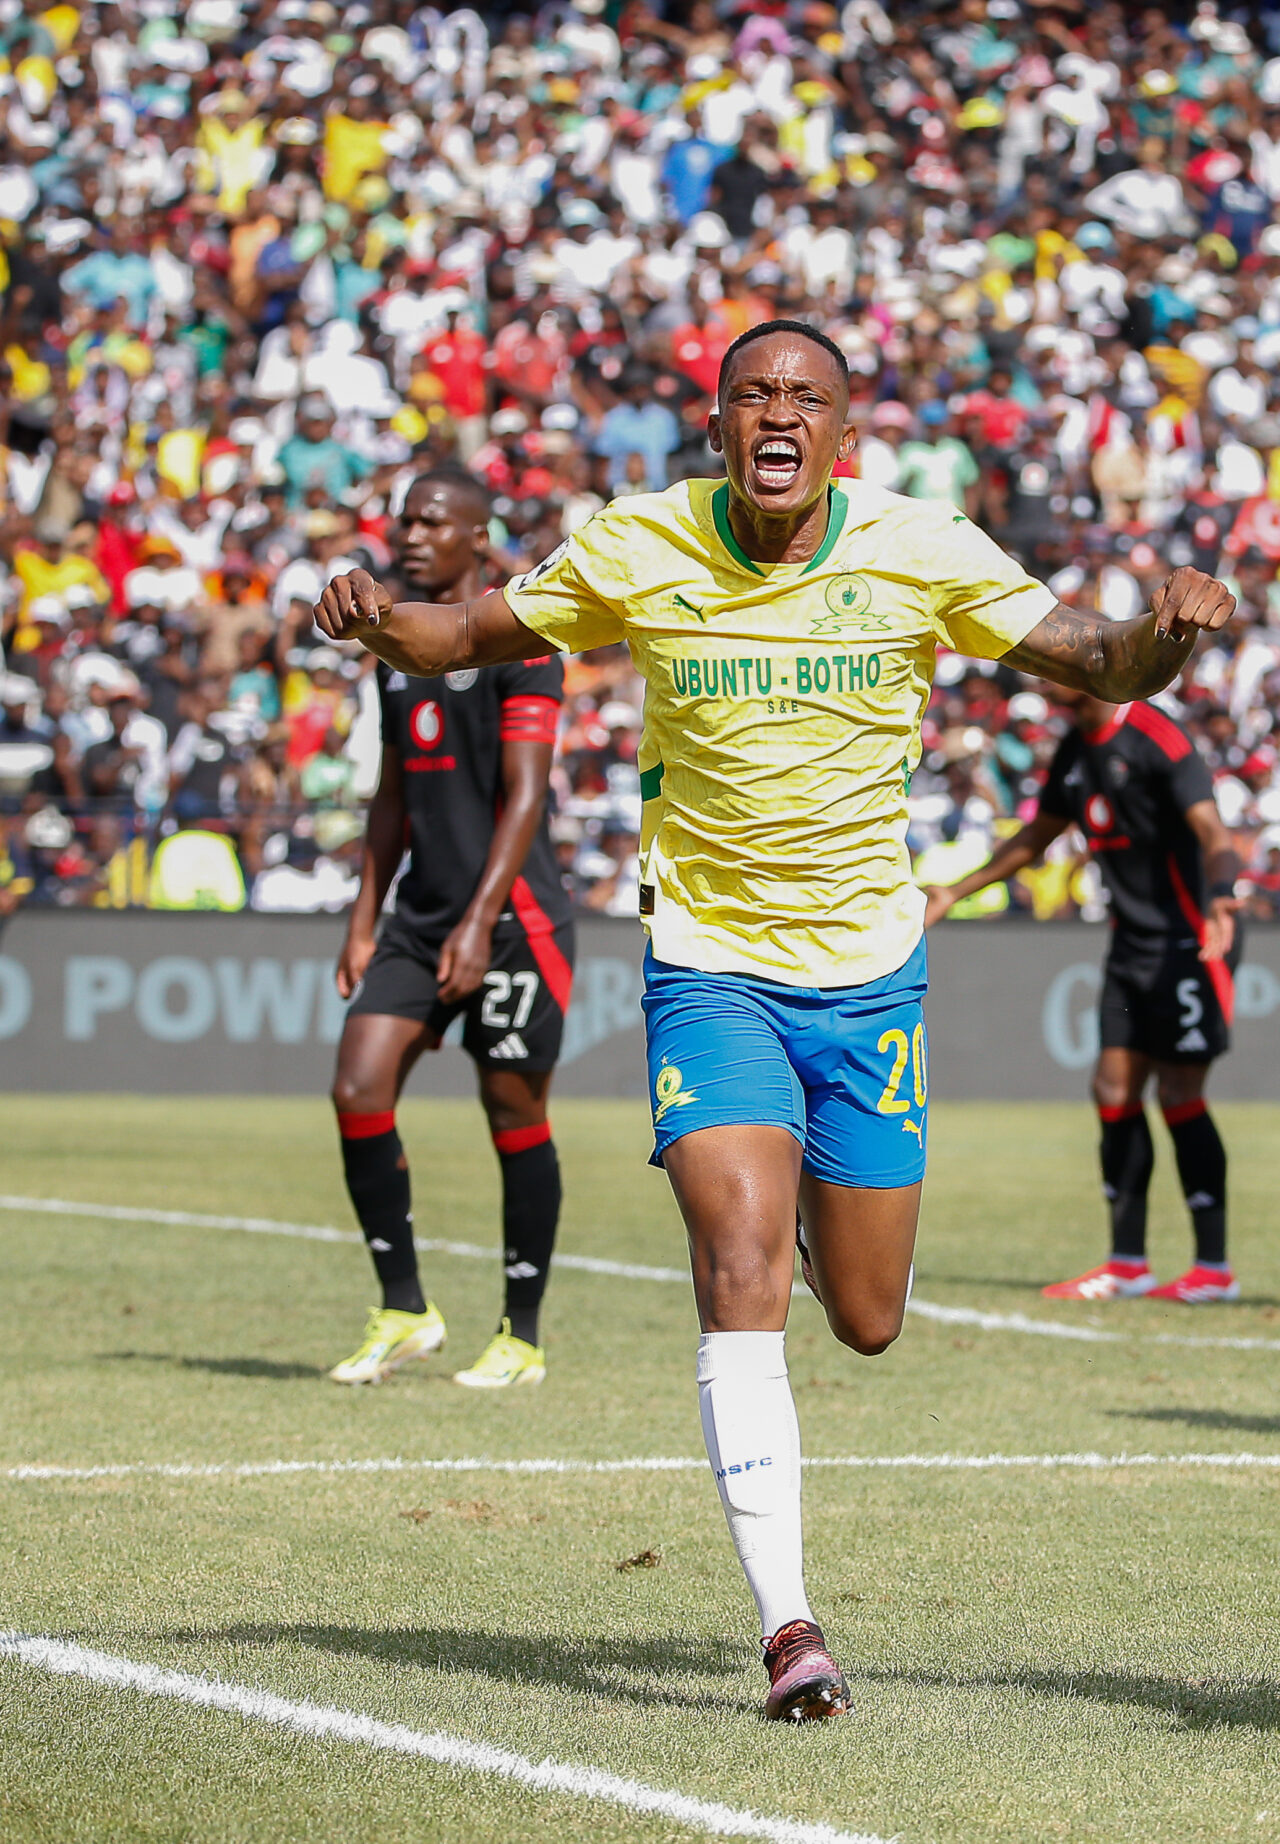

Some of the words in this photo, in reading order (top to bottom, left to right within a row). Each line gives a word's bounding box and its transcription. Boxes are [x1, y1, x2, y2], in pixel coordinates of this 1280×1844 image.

[672, 657, 772, 697] UBUNTU
[796, 653, 881, 694] BOTHO
[767, 700, 775, 713] S
[779, 700, 787, 713] &
[791, 700, 799, 712] E
[481, 970, 540, 1029] 27
[1176, 978, 1203, 1028] 5
[877, 1022, 927, 1114] 20
[716, 1456, 773, 1481] MSFC
